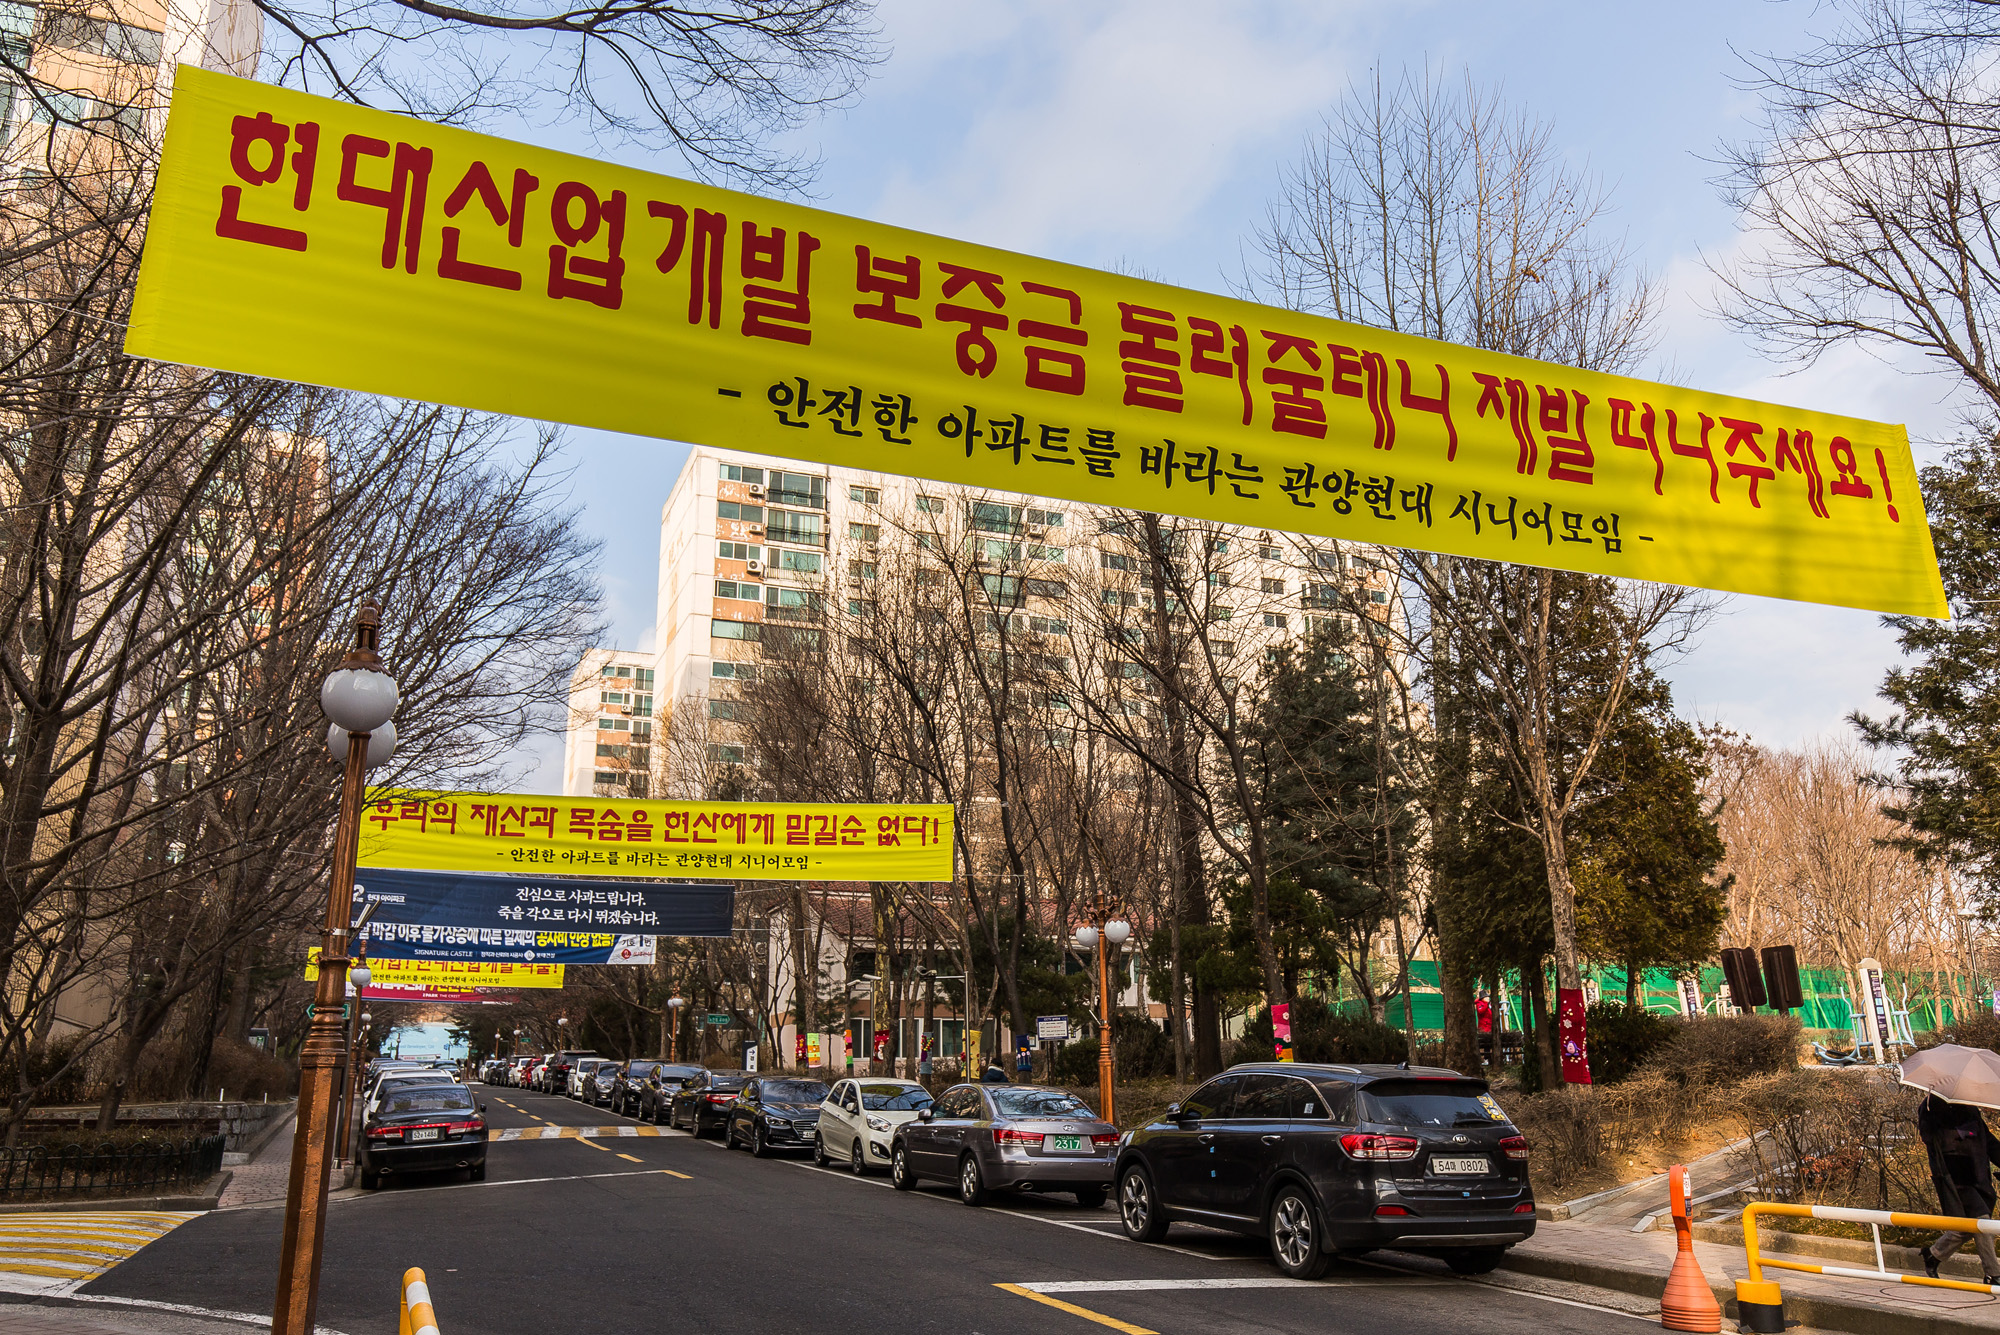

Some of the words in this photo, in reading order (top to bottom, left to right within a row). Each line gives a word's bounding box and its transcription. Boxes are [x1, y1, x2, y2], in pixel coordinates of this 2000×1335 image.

[216, 112, 820, 345] 현대산업개발
[1118, 302, 1458, 462] 돌려줄테니
[1472, 372, 1594, 484] 제발
[1608, 398, 1900, 523] 떠나주세요!
[768, 377, 918, 437] 안전한
[938, 405, 1120, 478] 아파트를
[1140, 439, 1263, 499] 바라는
[1279, 463, 1433, 528] 관양현대
[1449, 491, 1621, 552] 시니어모임
[470, 804, 558, 838] 재산과
[569, 808, 654, 842] 목숨을
[664, 811, 774, 845] 현산에게
[877, 815, 939, 847] 없다!
[510, 847, 556, 864] 안전한
[561, 850, 620, 866] 아파트를
[626, 852, 669, 867] 바라는
[675, 853, 732, 869] 관양현대
[738, 855, 809, 871] 시니어모임
[516, 887, 567, 902] 진심으로
[568, 889, 647, 906] 사과드립니다.
[498, 906, 524, 921] 죽을
[526, 907, 566, 922] 각오로
[568, 910, 592, 924] 다시
[595, 911, 660, 926] 뛰겠습니다.
[397, 924, 421, 943] 이후
[414, 949, 448, 957] SIGNATURE
[1055, 1139, 1080, 1149] 2317
[1460, 1160, 1484, 1171] 0802
